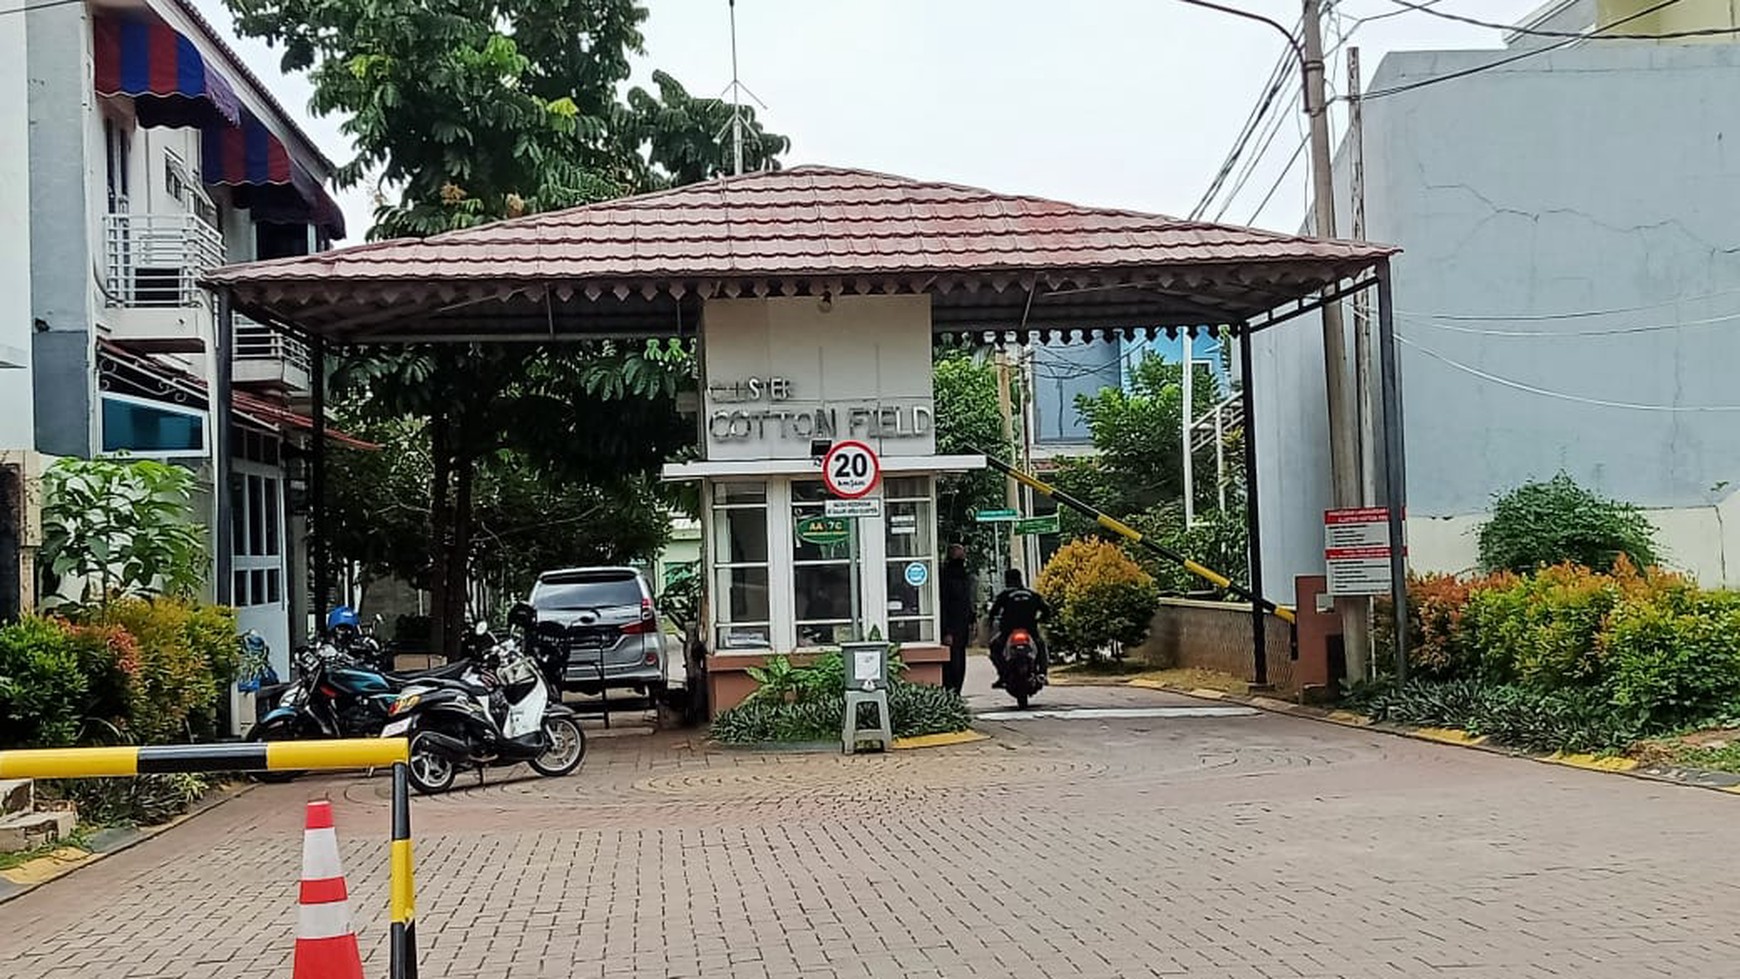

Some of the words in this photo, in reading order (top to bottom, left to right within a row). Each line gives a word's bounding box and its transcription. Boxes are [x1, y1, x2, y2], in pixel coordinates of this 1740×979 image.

[709, 408, 837, 439] COTTON
[850, 404, 931, 439] FIELD
[834, 453, 867, 477] 20
